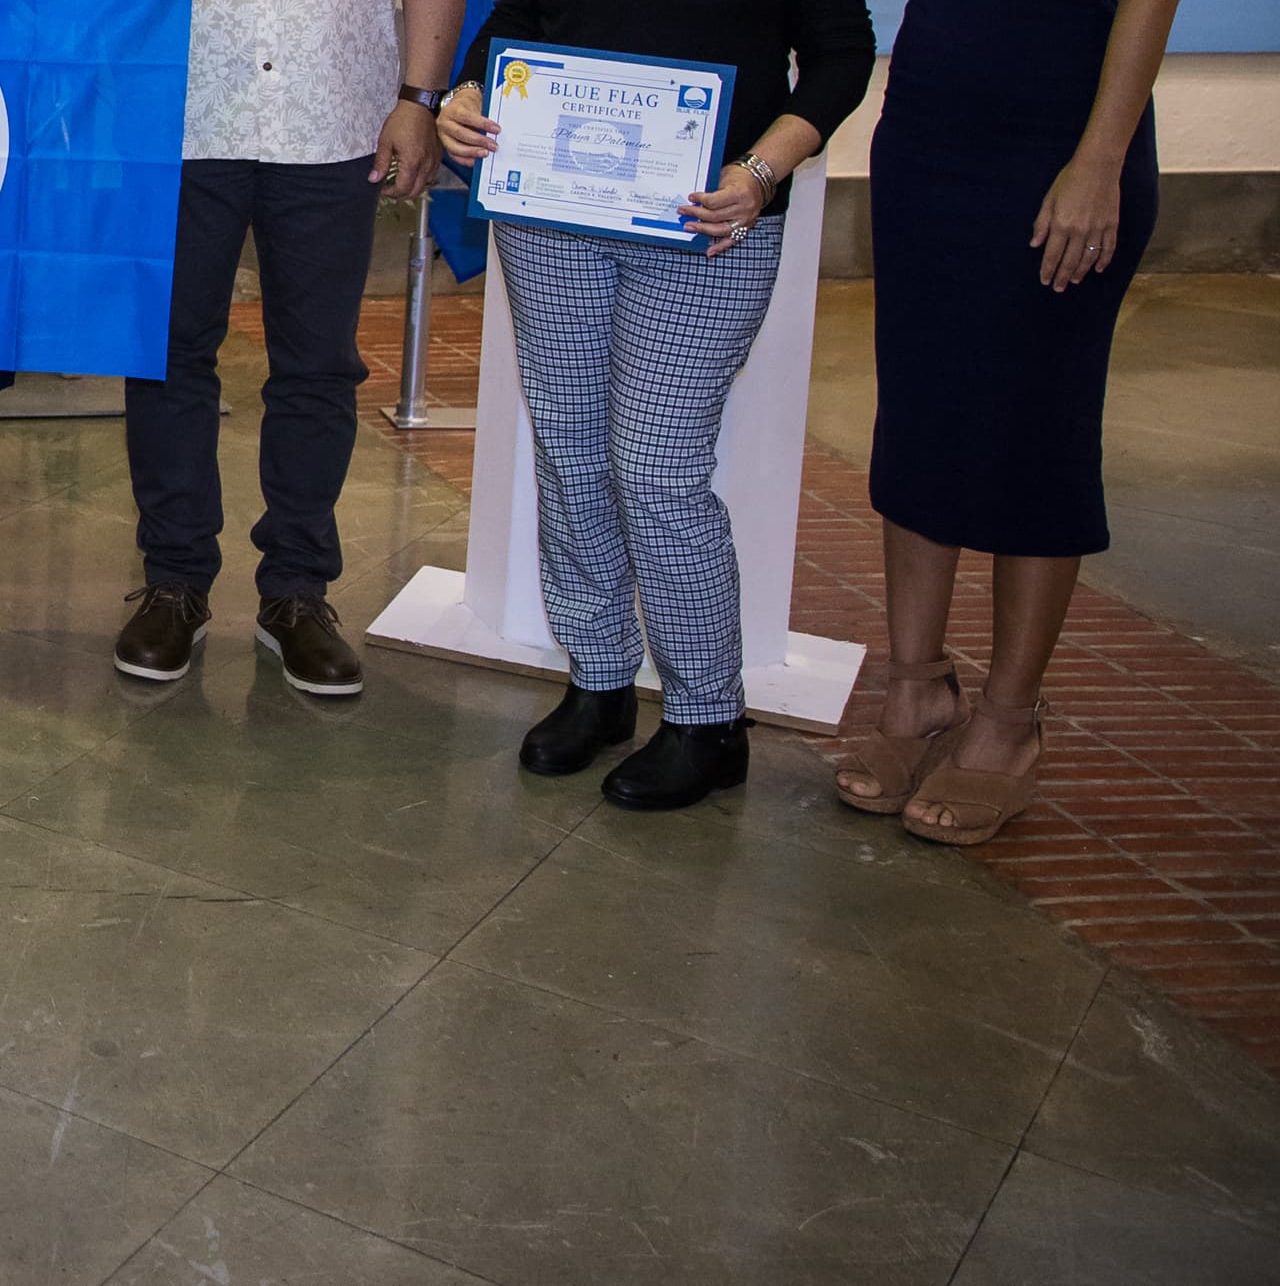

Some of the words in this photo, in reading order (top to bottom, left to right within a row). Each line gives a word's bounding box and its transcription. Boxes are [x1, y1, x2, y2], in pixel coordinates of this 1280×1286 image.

[550, 82, 599, 100] BLUE
[609, 89, 659, 108] FLAG
[562, 102, 641, 120] CERTIFICATE
[552, 127, 591, 143] Playa
[594, 132, 652, 149] Palomino
